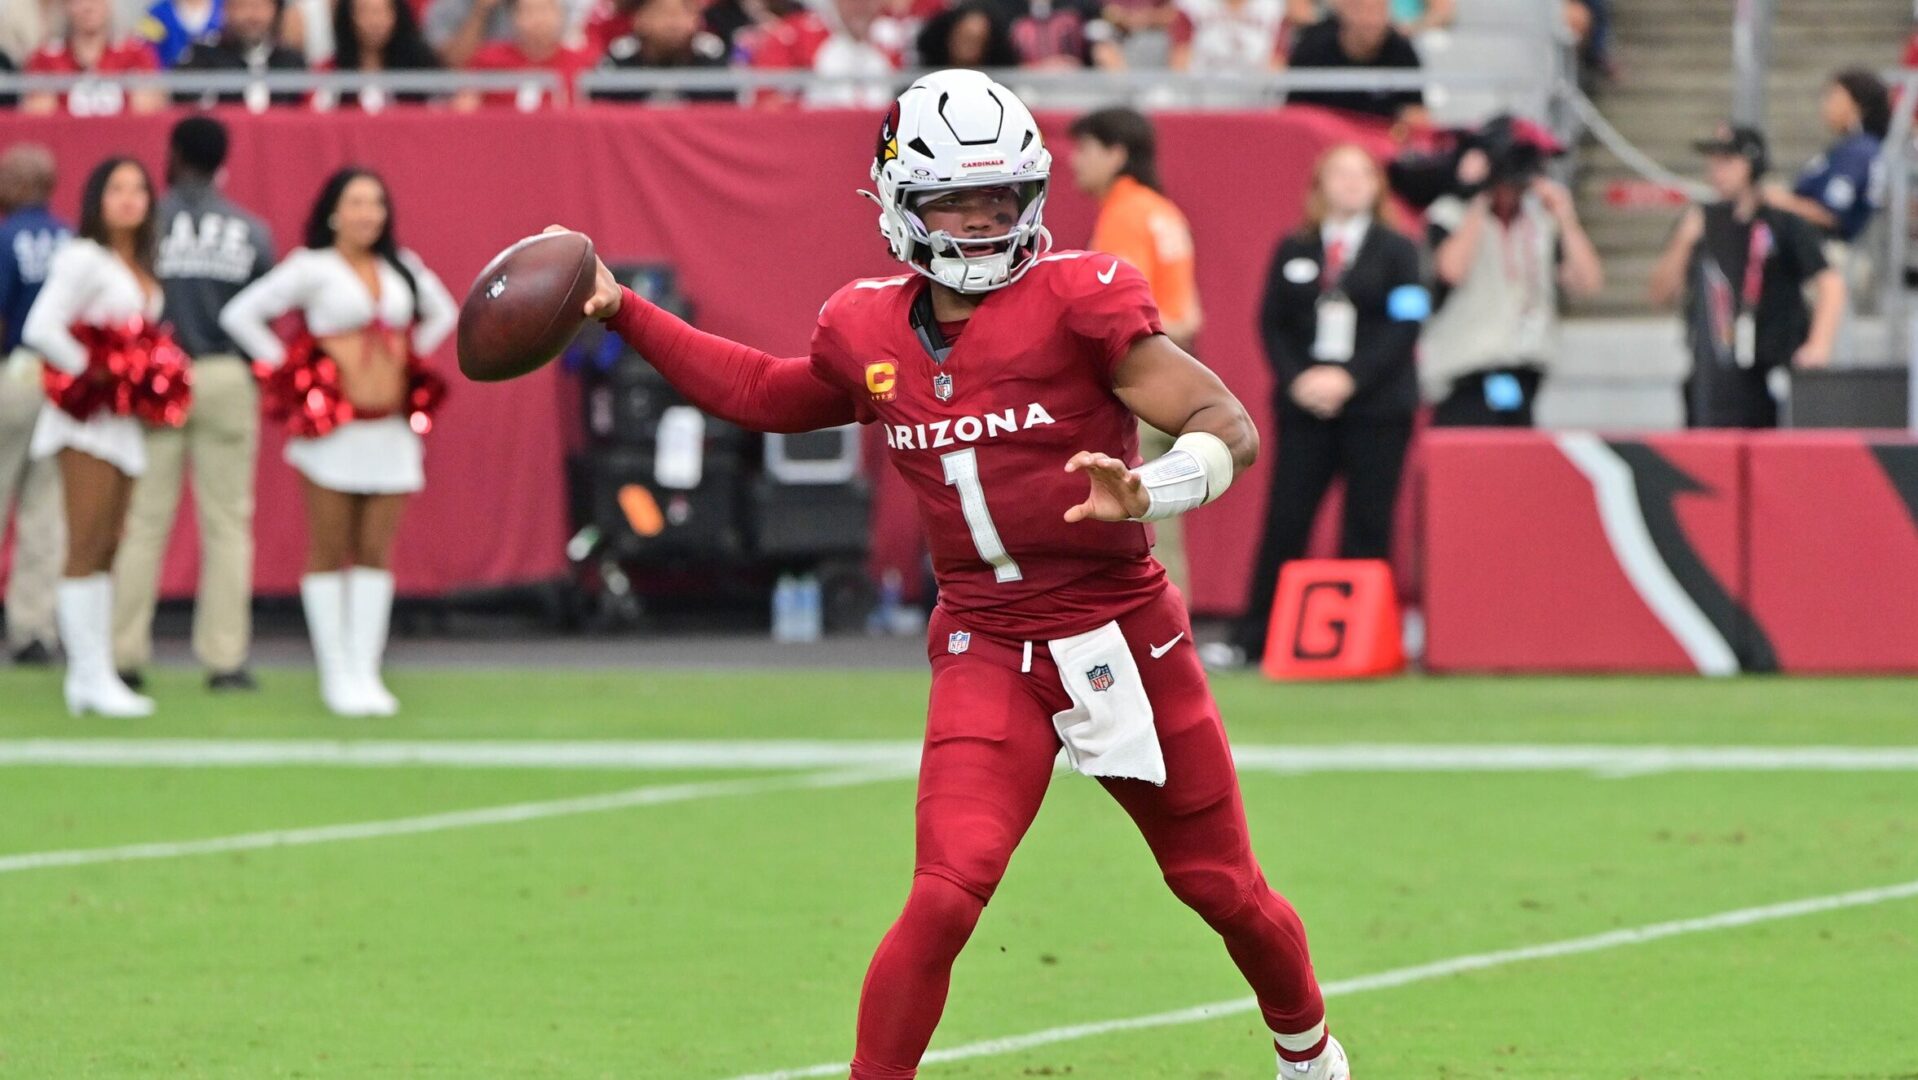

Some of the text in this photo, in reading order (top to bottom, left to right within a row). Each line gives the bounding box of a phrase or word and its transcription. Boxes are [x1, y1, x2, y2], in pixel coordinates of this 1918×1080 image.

[961, 160, 1004, 168] CARDINALS
[866, 362, 896, 393] C
[884, 403, 1056, 450] ARIZONA
[940, 447, 1023, 584] 1
[1293, 580, 1353, 661] G
